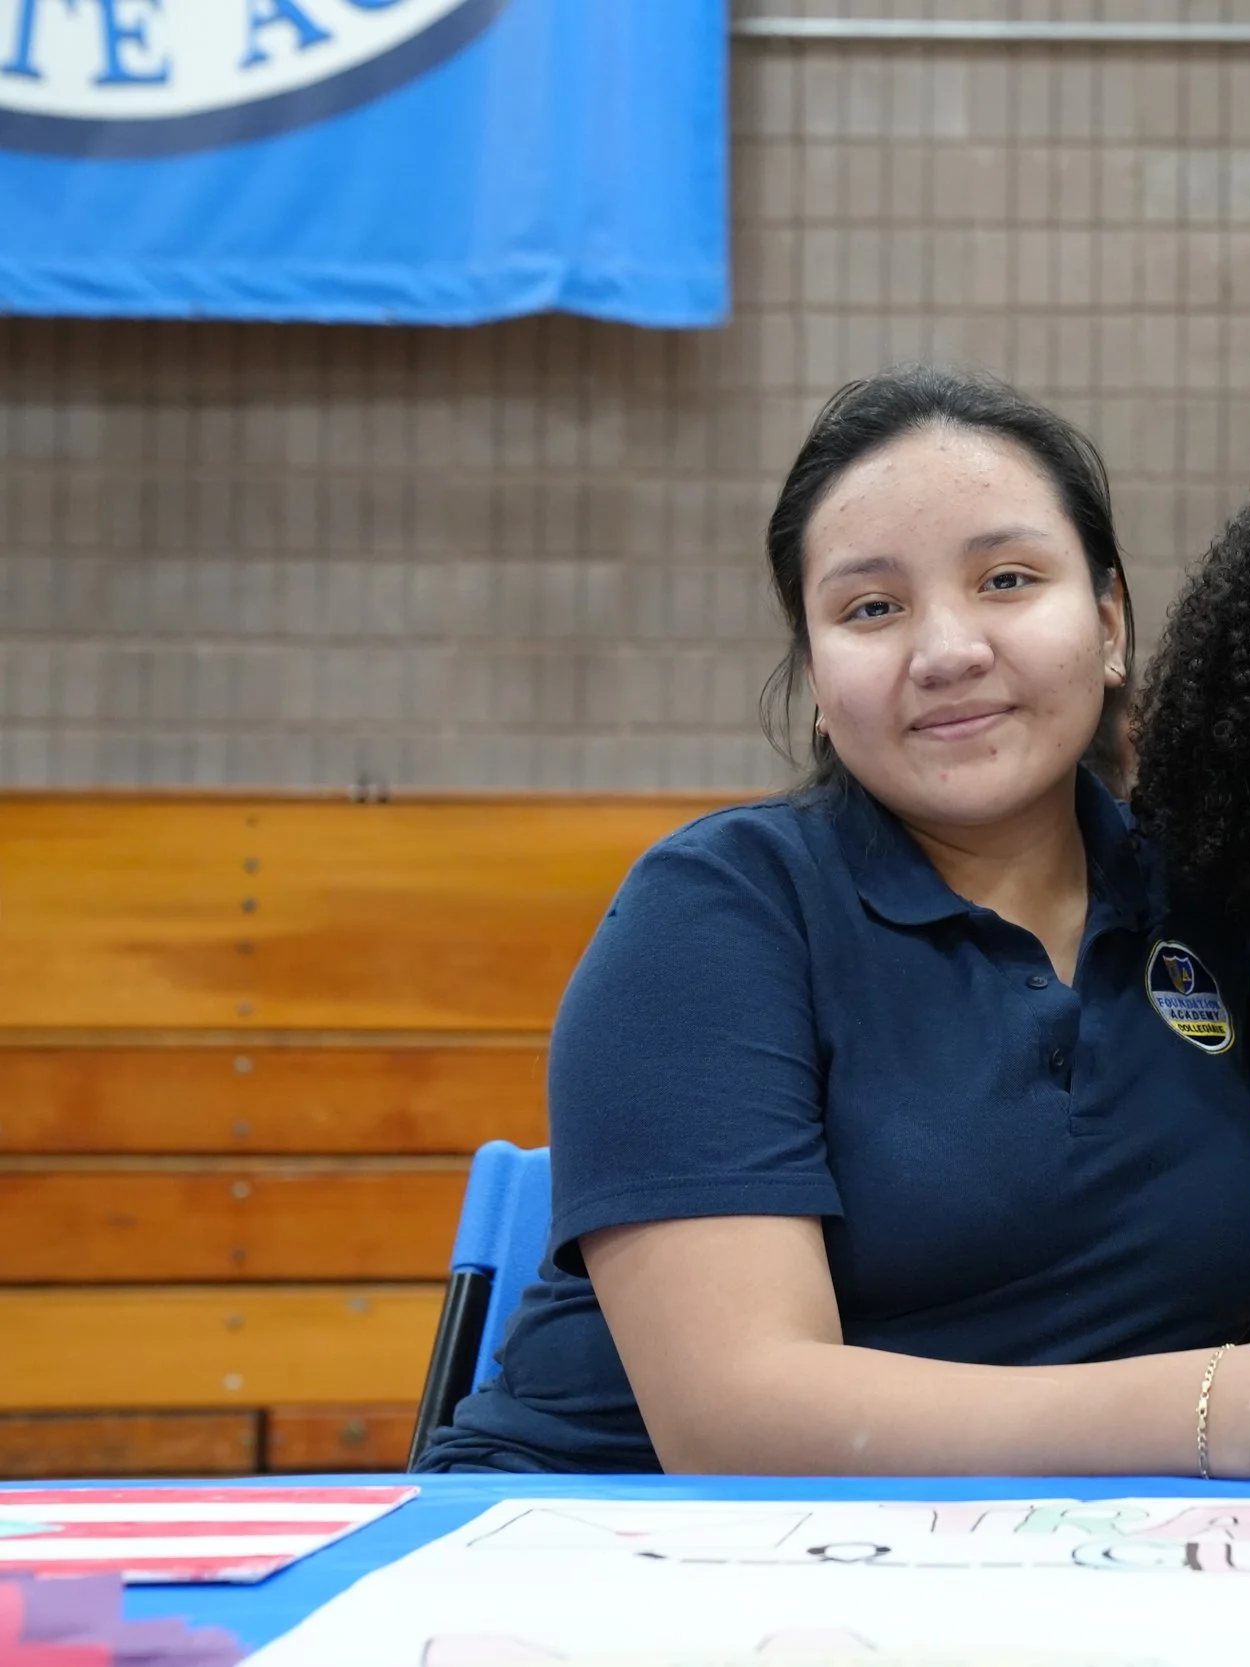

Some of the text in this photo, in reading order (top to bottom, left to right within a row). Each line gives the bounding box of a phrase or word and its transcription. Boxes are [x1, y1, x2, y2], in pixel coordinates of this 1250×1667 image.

[239, 0, 404, 69] A
[1157, 996, 1222, 1010] FOUNDATION
[1170, 1009, 1220, 1021] ACADEMY
